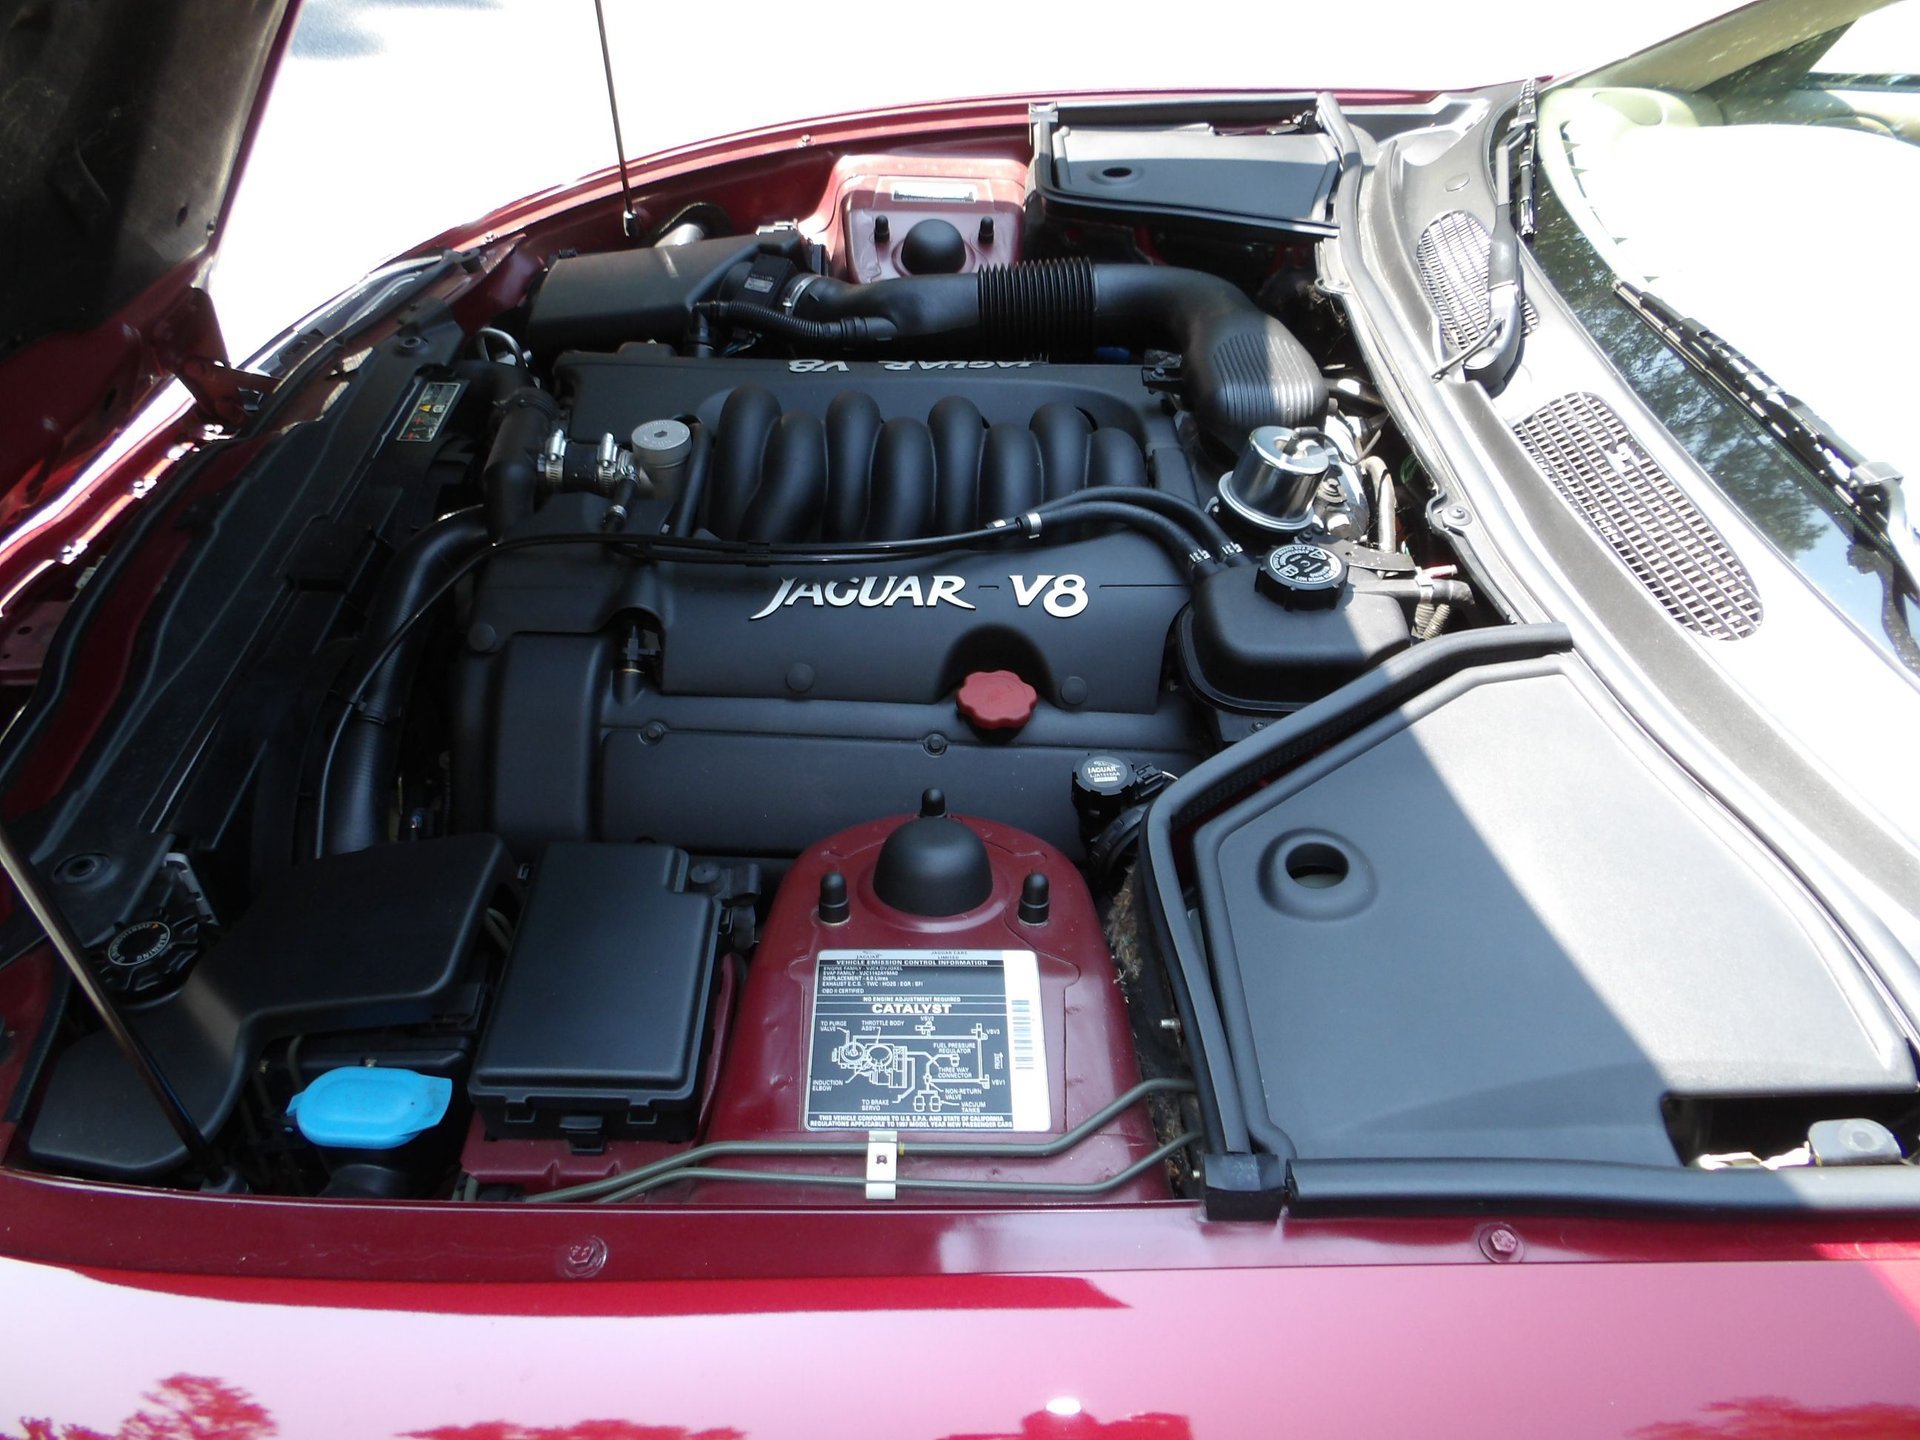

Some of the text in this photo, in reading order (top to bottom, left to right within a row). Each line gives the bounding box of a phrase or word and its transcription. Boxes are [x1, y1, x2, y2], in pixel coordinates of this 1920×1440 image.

[787, 359, 1034, 373] JAGUAR V8
[750, 574, 1089, 620] JAGUAR V8
[1088, 766, 1117, 775] JAGUAR
[871, 1003, 952, 1014] CATALYST
